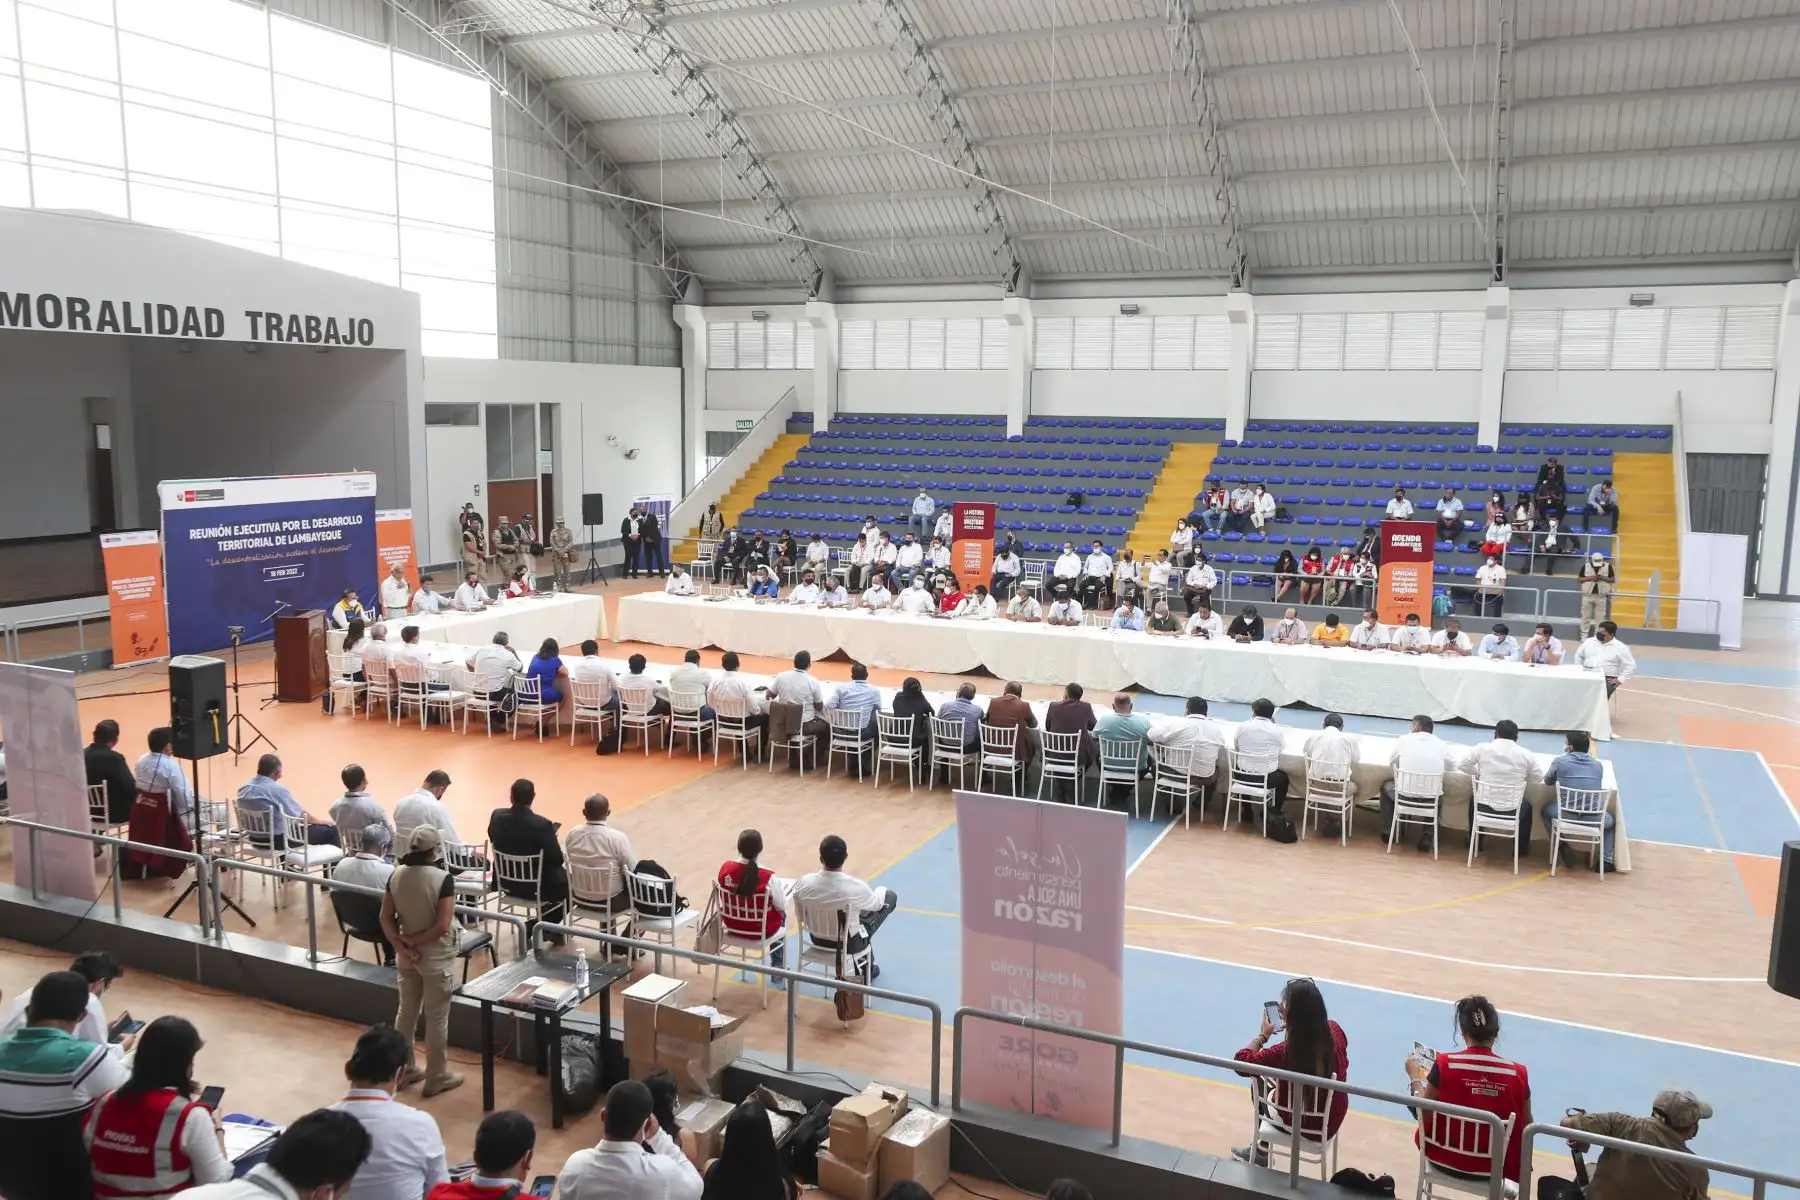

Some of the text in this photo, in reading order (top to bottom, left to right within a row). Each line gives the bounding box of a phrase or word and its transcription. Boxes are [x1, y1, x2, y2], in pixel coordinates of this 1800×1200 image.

[0, 291, 375, 347] MORALIDAD TRABAJO
[189, 515, 363, 540] REUNIÓN EJECUTIVA POR EL DESARROLLO
[218, 530, 342, 552] TERRITORIAL DE LAMBAYEQUE
